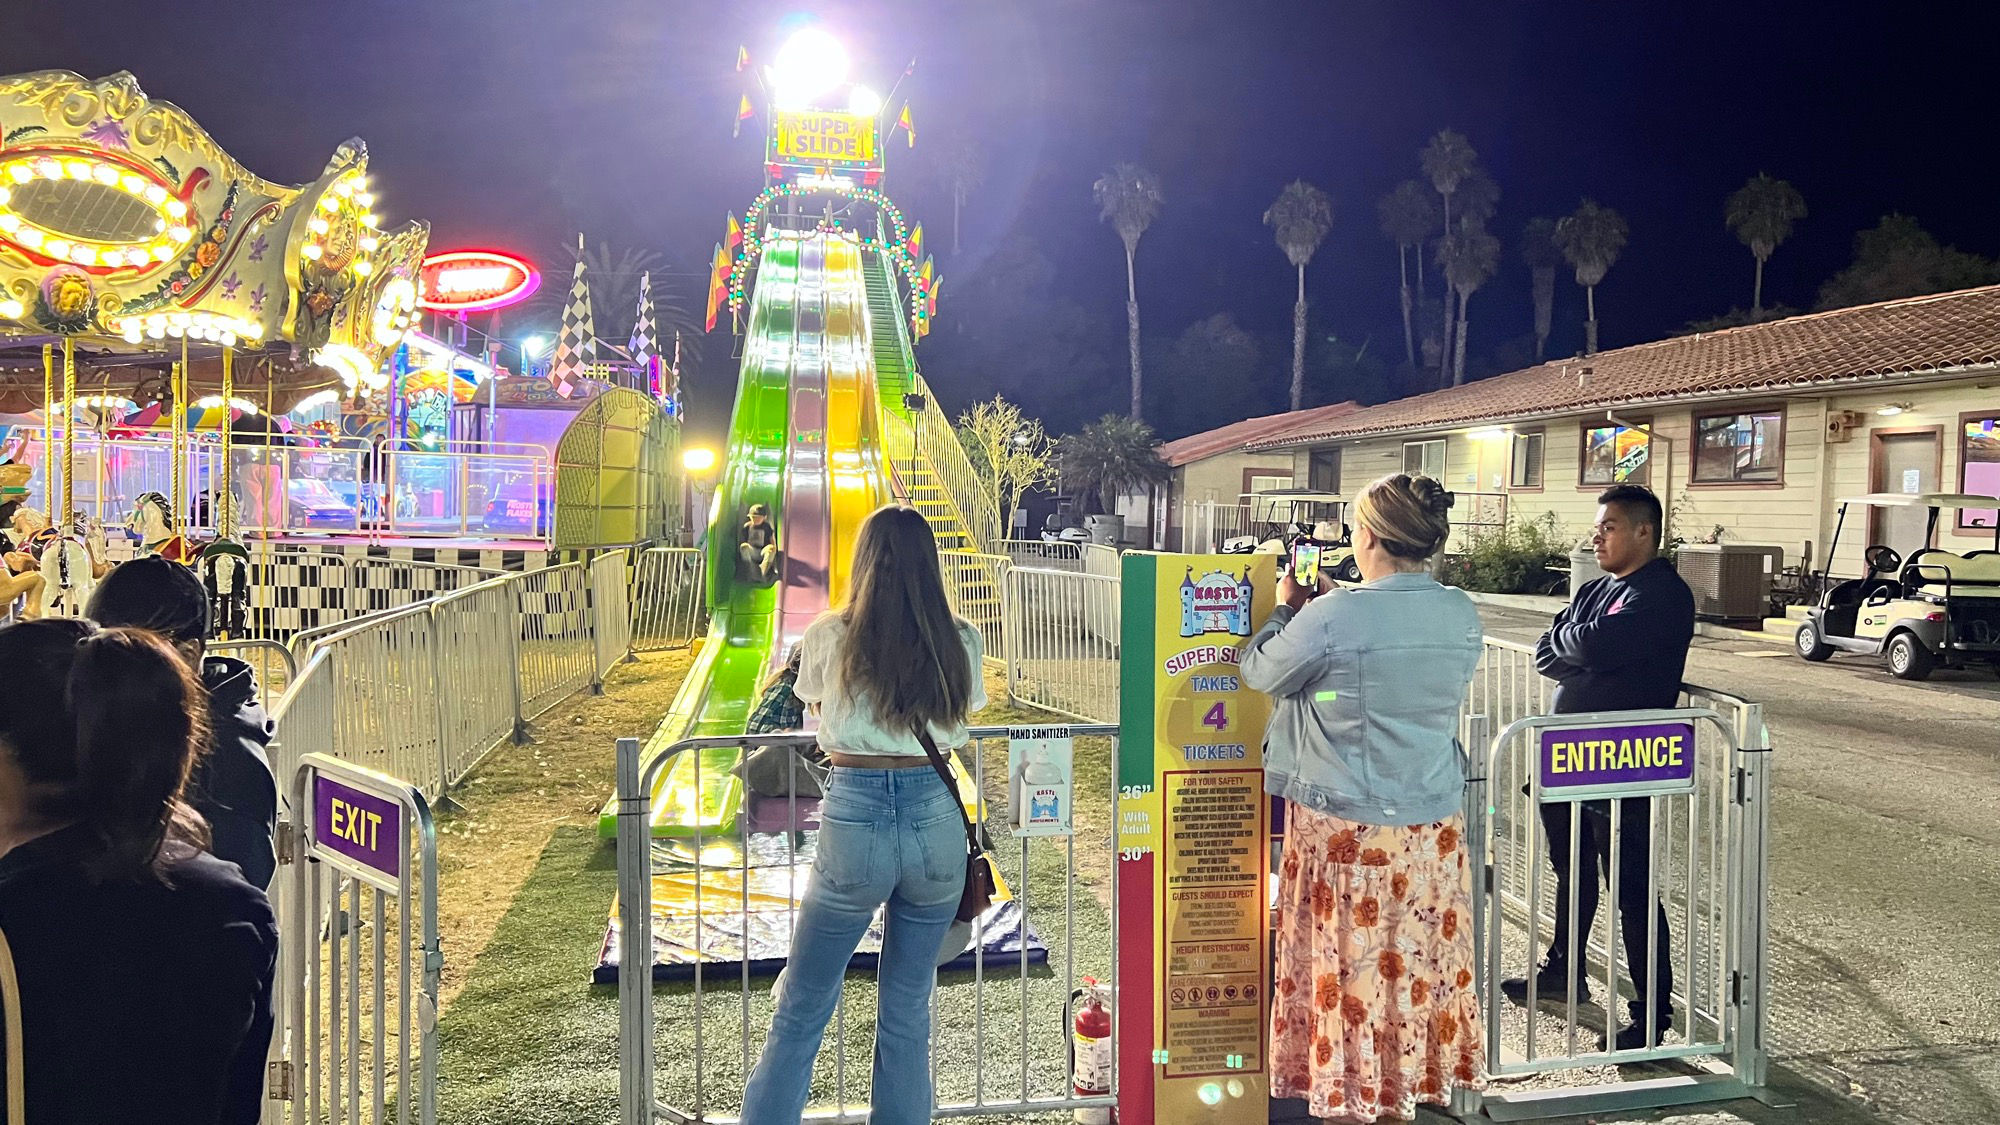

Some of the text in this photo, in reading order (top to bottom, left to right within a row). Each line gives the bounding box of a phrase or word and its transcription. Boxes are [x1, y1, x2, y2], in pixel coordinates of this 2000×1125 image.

[802, 117, 849, 135] SUPER
[796, 135, 857, 156] SLIDE
[1194, 586, 1239, 600] KASTL
[1166, 647, 1216, 674] SUPER
[1191, 677, 1239, 691] TAKES
[1203, 701, 1228, 730] 4
[1010, 727, 1069, 740] HAND SANITIZER
[1183, 745, 1245, 760] TICKETS
[1551, 735, 1683, 774] ENTRANCE
[1183, 776, 1244, 786] FOR YOUR SAFETY
[1123, 811, 1149, 823] With
[331, 797, 382, 852] EXIT
[1121, 823, 1151, 834] Adult
[1172, 889, 1254, 901] GUESTS SHOULD EXPECT
[1176, 943, 1250, 955] HEIGHT RESTRICTIONS
[1198, 1009, 1230, 1018] WARNING
